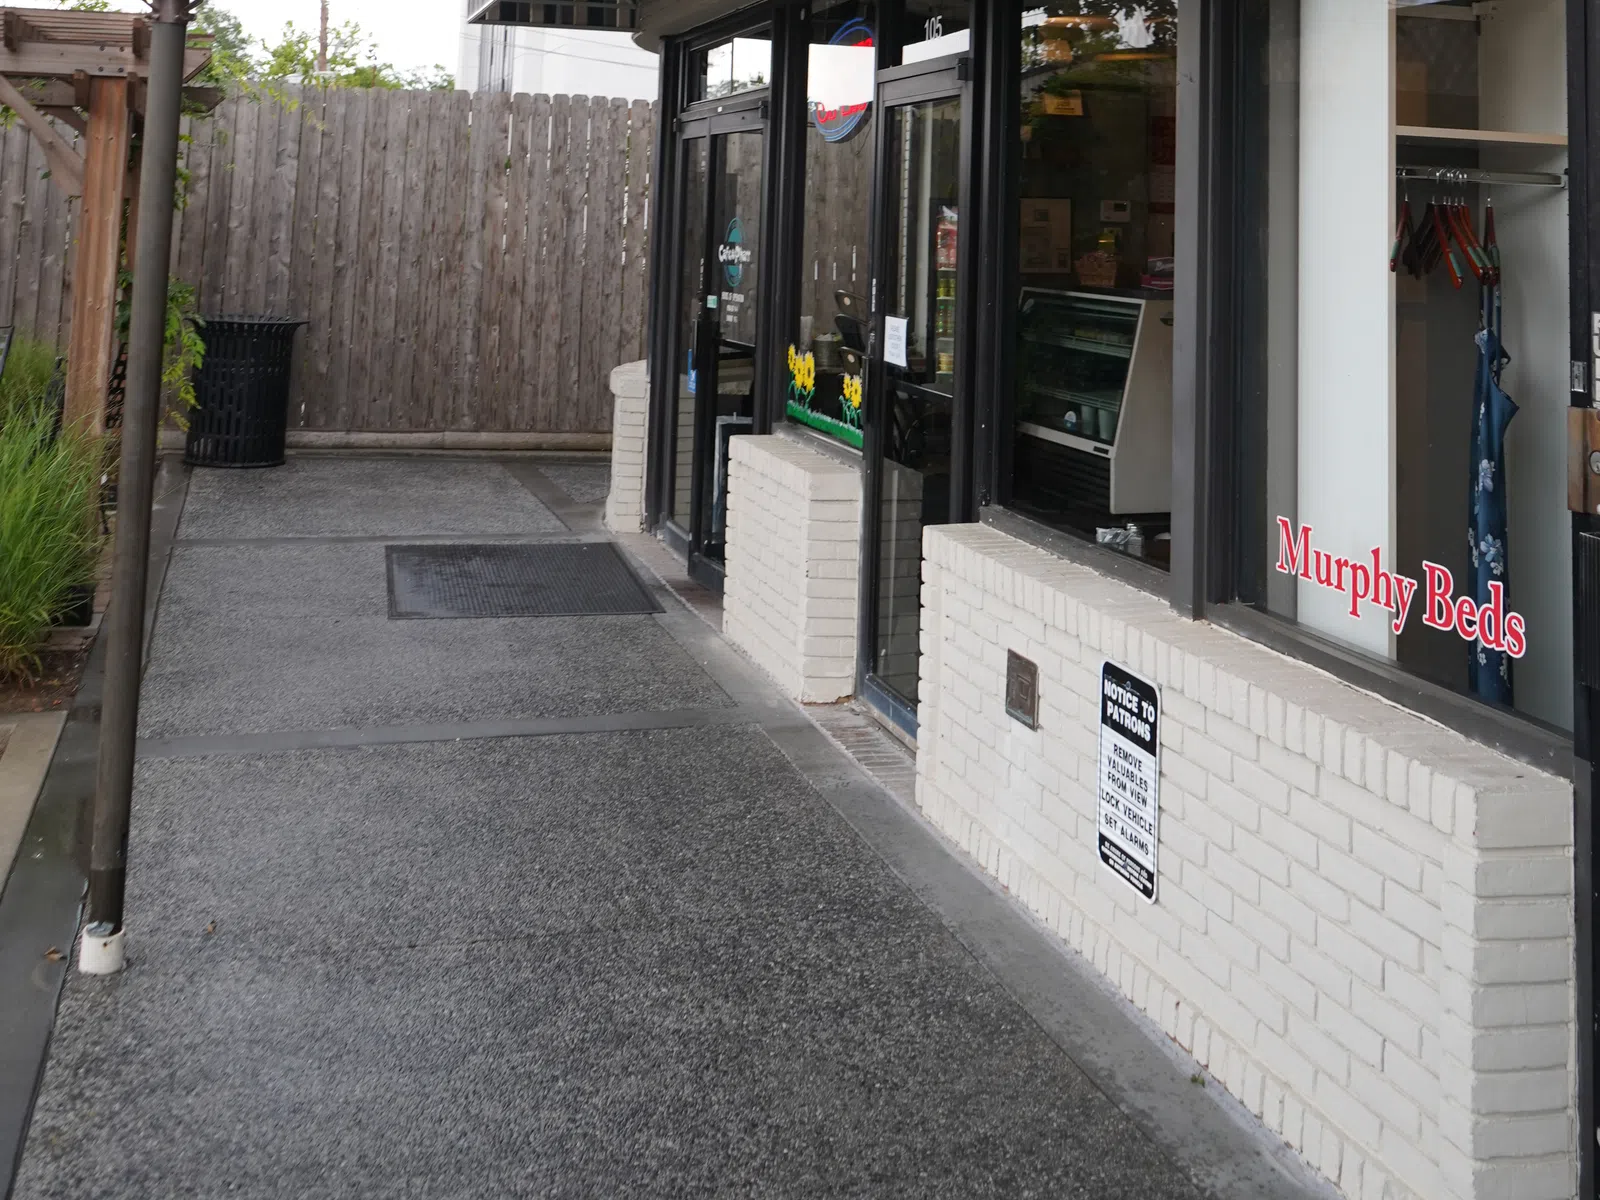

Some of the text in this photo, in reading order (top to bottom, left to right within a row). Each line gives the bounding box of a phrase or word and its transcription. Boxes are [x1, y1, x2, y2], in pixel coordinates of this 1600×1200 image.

[924, 14, 943, 42] 105
[1276, 516, 1526, 659] Murphy Beds
[1104, 679, 1155, 723] NOTICE TO
[1106, 700, 1151, 742] PATRONS
[1107, 754, 1148, 793] VALUABLES
[1113, 743, 1142, 772] REMOVE
[1107, 770, 1148, 808] FROM VIEW
[1101, 788, 1153, 836] LOCK VEHICLE
[1104, 812, 1149, 856] SET ALARMS
